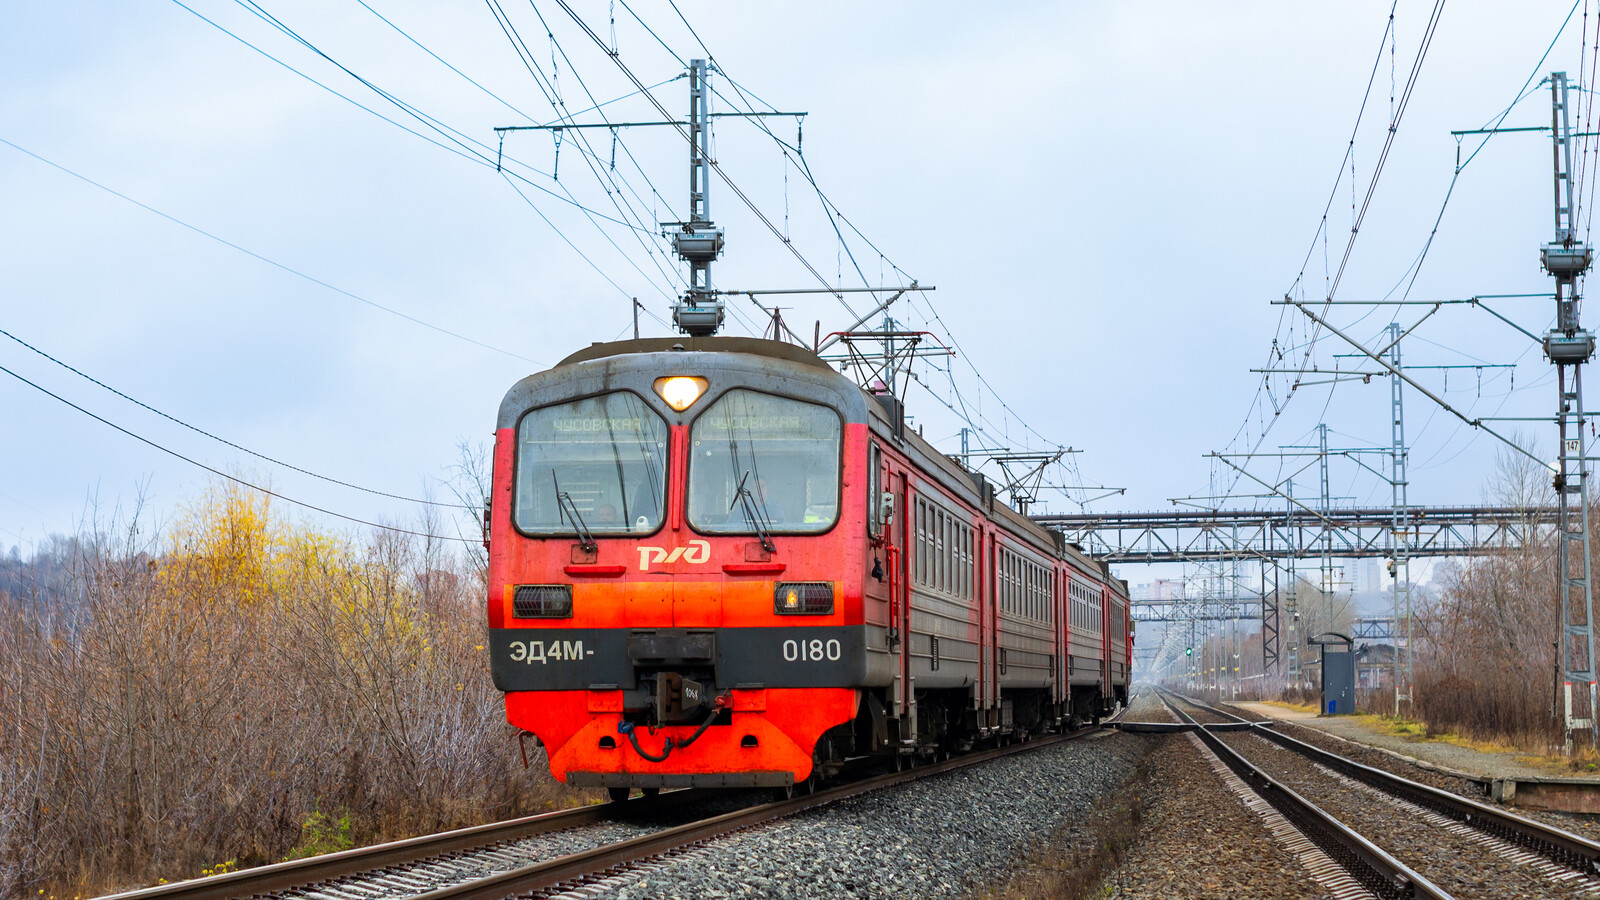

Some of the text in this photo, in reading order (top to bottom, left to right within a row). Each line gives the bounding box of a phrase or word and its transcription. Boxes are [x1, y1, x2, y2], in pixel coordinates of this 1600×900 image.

[553, 418, 641, 432] ЧУСОВСКАЯ
[710, 416, 799, 429] ЧУСОВСКАЯ
[1565, 441, 1578, 451] 147
[509, 640, 595, 664] ЭД4М-
[783, 639, 841, 661] 0180
